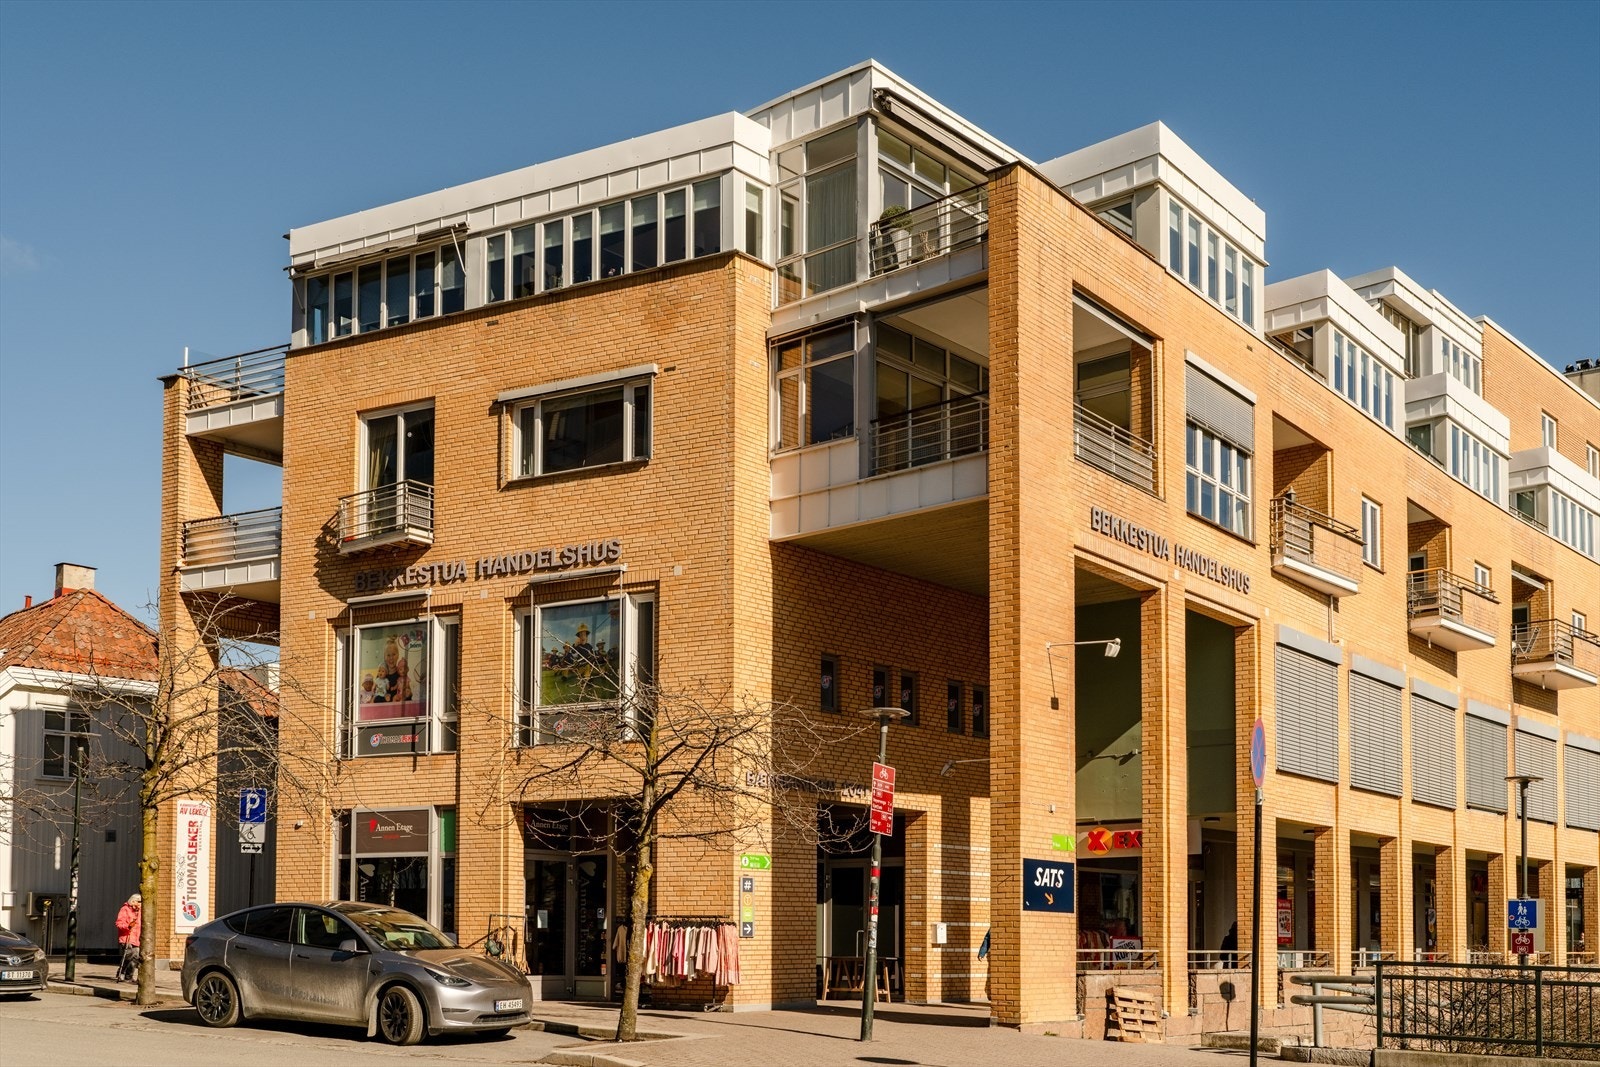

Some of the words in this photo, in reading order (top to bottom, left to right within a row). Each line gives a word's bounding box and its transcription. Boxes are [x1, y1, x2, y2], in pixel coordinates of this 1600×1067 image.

[355, 560, 466, 591] BEKKESTUA
[477, 538, 621, 576] HANDELSHUS
[1091, 506, 1170, 561] BEKKESTUA
[1175, 543, 1250, 594] HANDELSHUS
[246, 793, 260, 818] P
[376, 823, 396, 832] Annen
[187, 820, 198, 902] THOMASLEKER
[1034, 867, 1065, 889] SATS
